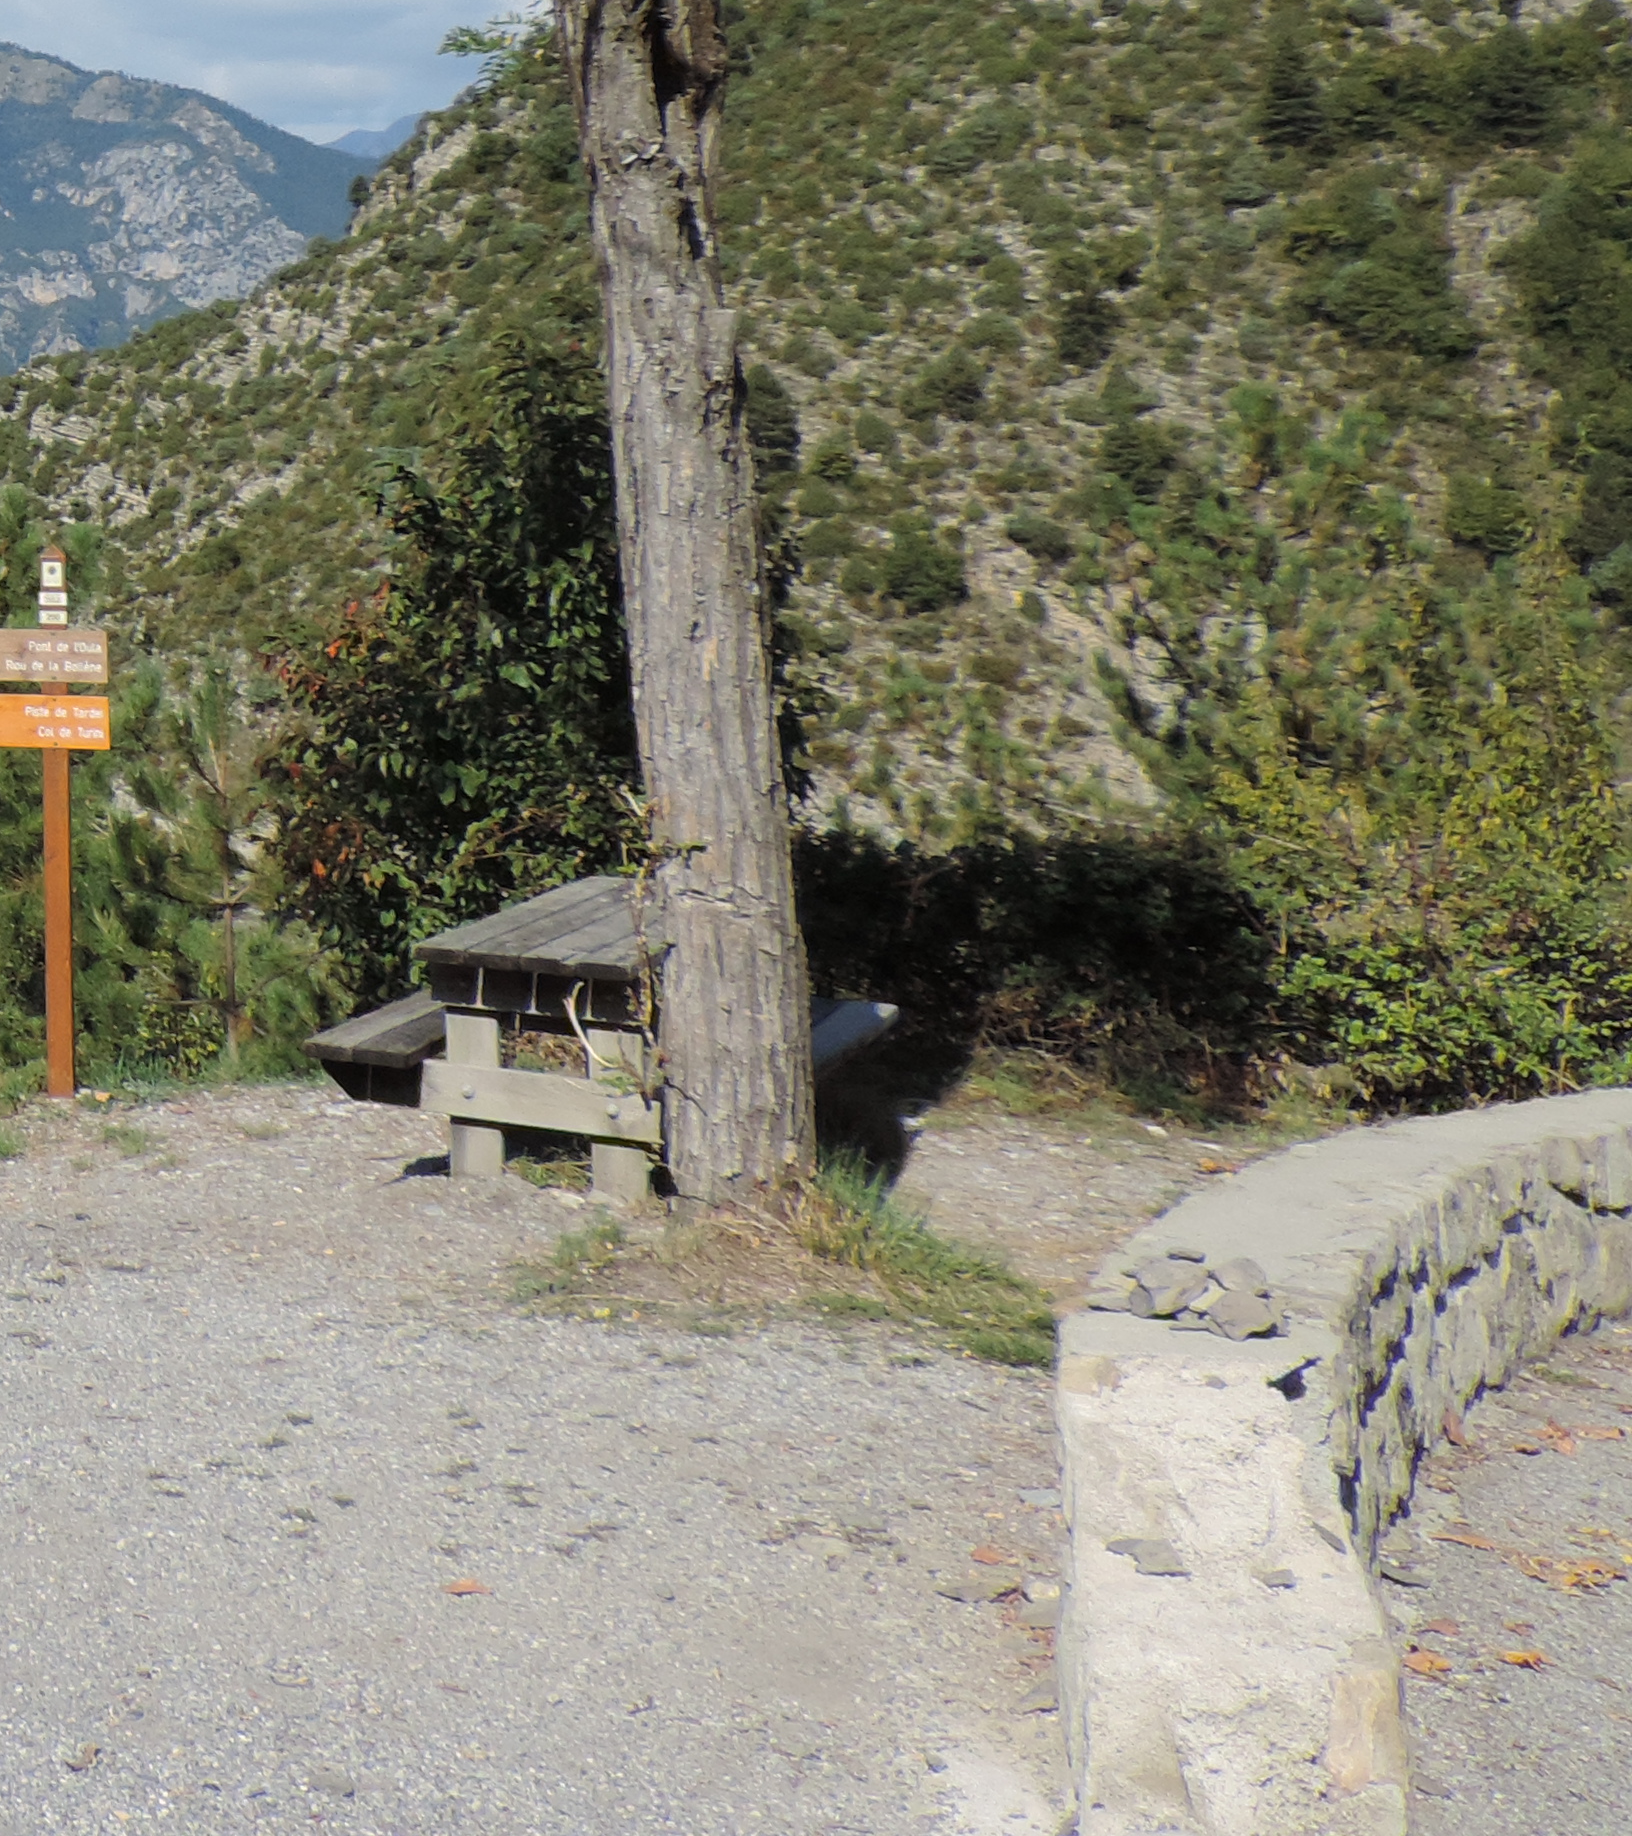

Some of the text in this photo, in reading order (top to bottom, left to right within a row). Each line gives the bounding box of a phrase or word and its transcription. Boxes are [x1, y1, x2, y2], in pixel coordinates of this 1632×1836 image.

[56, 642, 69, 652] de
[31, 660, 44, 672] de
[48, 660, 59, 672] la
[54, 707, 68, 718] de
[58, 726, 72, 738] de
